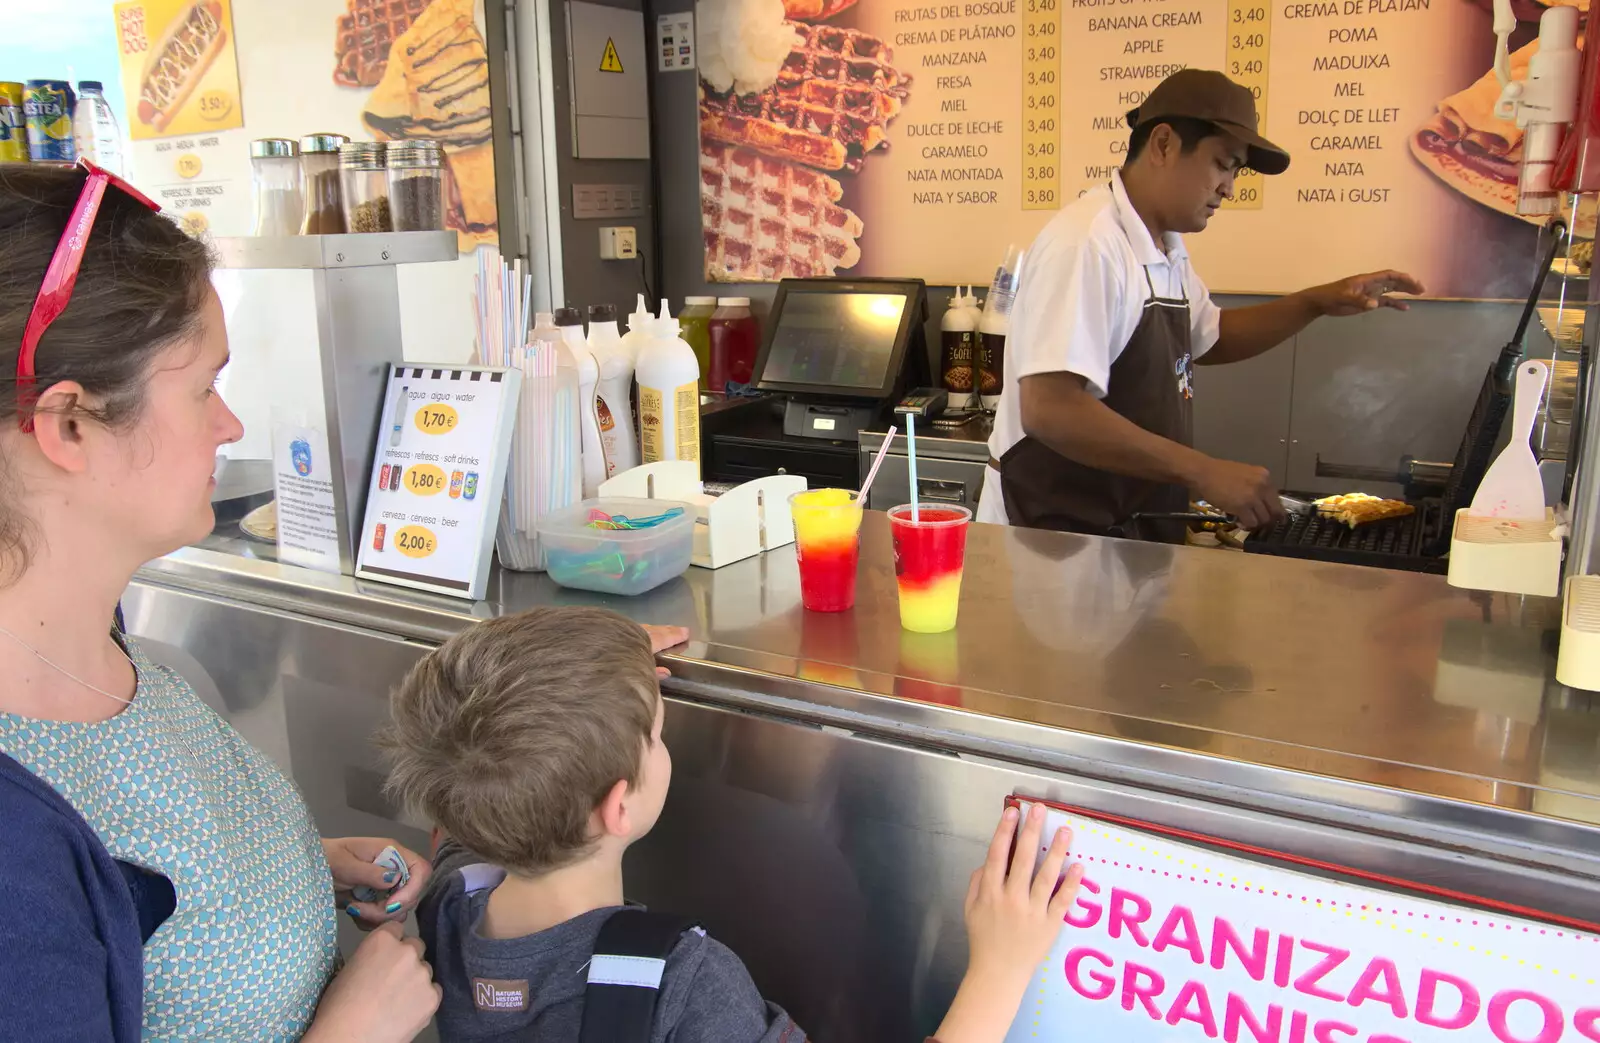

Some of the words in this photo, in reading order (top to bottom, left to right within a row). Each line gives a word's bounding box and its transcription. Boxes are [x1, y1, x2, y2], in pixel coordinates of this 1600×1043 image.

[120, 6, 144, 21] SUPER
[894, 7, 937, 23] FRUTAS
[940, 5, 961, 18] DEL
[964, 0, 1016, 16] BOSQUE
[1027, 0, 1056, 13] 3,40
[1284, 4, 1339, 19] CREMA
[1343, 1, 1364, 15] DE
[1088, 15, 1149, 31] BANANA
[1151, 11, 1202, 27] CREAM
[1232, 7, 1265, 24] 3,40
[121, 20, 145, 37] HOT
[895, 30, 937, 46] CREMA
[940, 29, 956, 42] DE
[959, 24, 1016, 40] PLÁTANO
[1027, 22, 1056, 37] 3,40
[1328, 27, 1379, 43] POMA
[123, 36, 148, 55] DOG
[1123, 39, 1164, 54] APPLE
[1231, 34, 1264, 50] 3,40
[922, 51, 988, 67] MANZANA
[1027, 47, 1056, 62] 3,40
[1231, 60, 1263, 76] 3,40
[1312, 54, 1391, 72] MADUIXA
[936, 76, 973, 89] FRESA
[1027, 71, 1056, 87] 3,40
[1333, 82, 1365, 97] MEL
[1027, 95, 1056, 110] 3,40
[1118, 91, 1151, 104] HON
[24, 102, 61, 116] ESTEA
[940, 100, 968, 112] MIEL
[1092, 116, 1124, 131] MILK
[1298, 110, 1340, 128] DOLÇ
[1344, 109, 1364, 123] DE
[1368, 107, 1400, 123] LLET
[906, 123, 945, 137] DULCE
[948, 122, 963, 135] DE
[966, 121, 1004, 134] LECHE
[1027, 119, 1056, 134] 3,40
[1027, 143, 1056, 157] 3,40
[1310, 135, 1383, 150] CARAMEL
[921, 145, 988, 159] CARAMELO
[907, 169, 937, 182] NATA
[940, 168, 1004, 182] MONTADA
[1027, 166, 1055, 181] 3,80
[1325, 162, 1365, 177] NATA
[913, 192, 943, 205] NATA
[944, 192, 955, 204] Y
[956, 191, 998, 204] SABOR
[1027, 190, 1055, 204] 3,80
[1297, 188, 1336, 203] NATA
[1347, 187, 1391, 202] GUST
[76, 201, 95, 236] canvas
[407, 391, 427, 402] agua
[430, 391, 451, 402] aigua
[455, 393, 476, 403] water
[422, 410, 446, 428] 1,70
[384, 449, 411, 459] refrescos
[414, 452, 440, 462] refrescs
[443, 454, 457, 464] soft
[457, 456, 480, 466] drinks
[411, 471, 434, 488] 1,80
[381, 511, 406, 521] cerveza
[410, 514, 437, 525] cervesa
[441, 516, 459, 527] beer
[399, 532, 425, 550] 2,00
